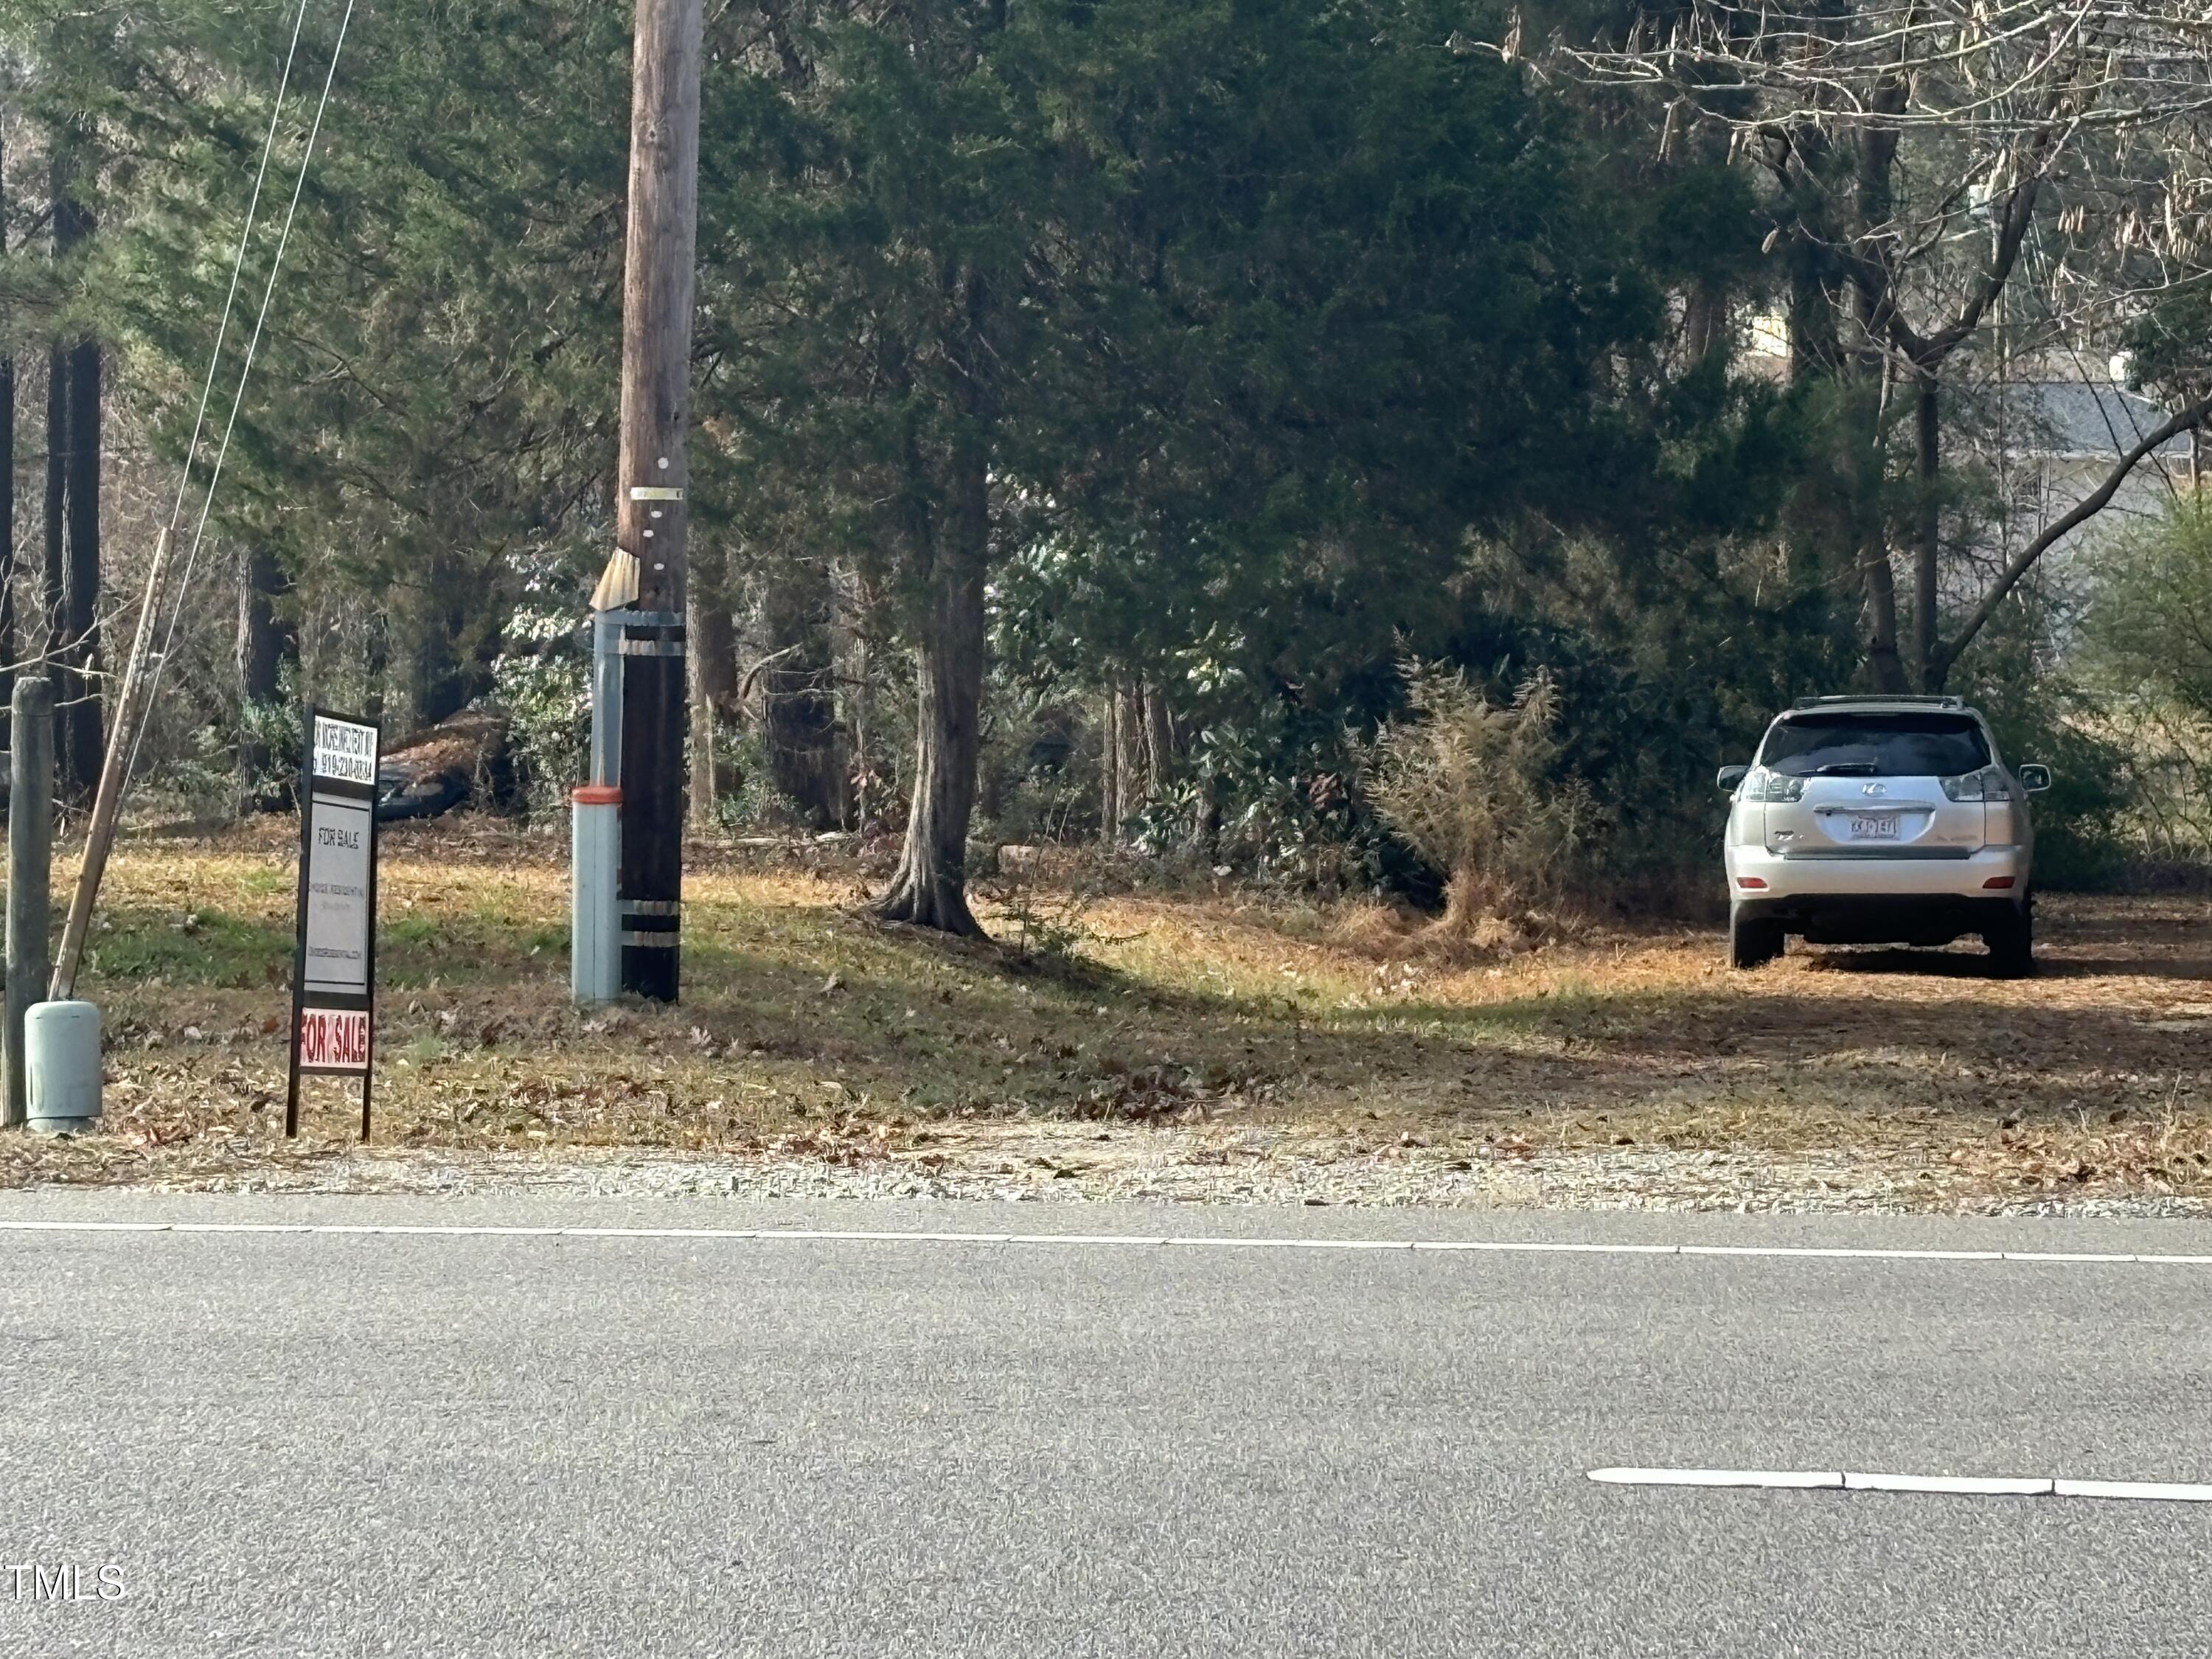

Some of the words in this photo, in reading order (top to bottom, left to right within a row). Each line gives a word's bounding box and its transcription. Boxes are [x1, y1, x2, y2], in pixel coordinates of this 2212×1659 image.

[319, 827, 335, 846] FOR
[338, 830, 360, 849] SALE
[300, 1013, 326, 1062] FOR
[333, 1015, 366, 1062] SALE
